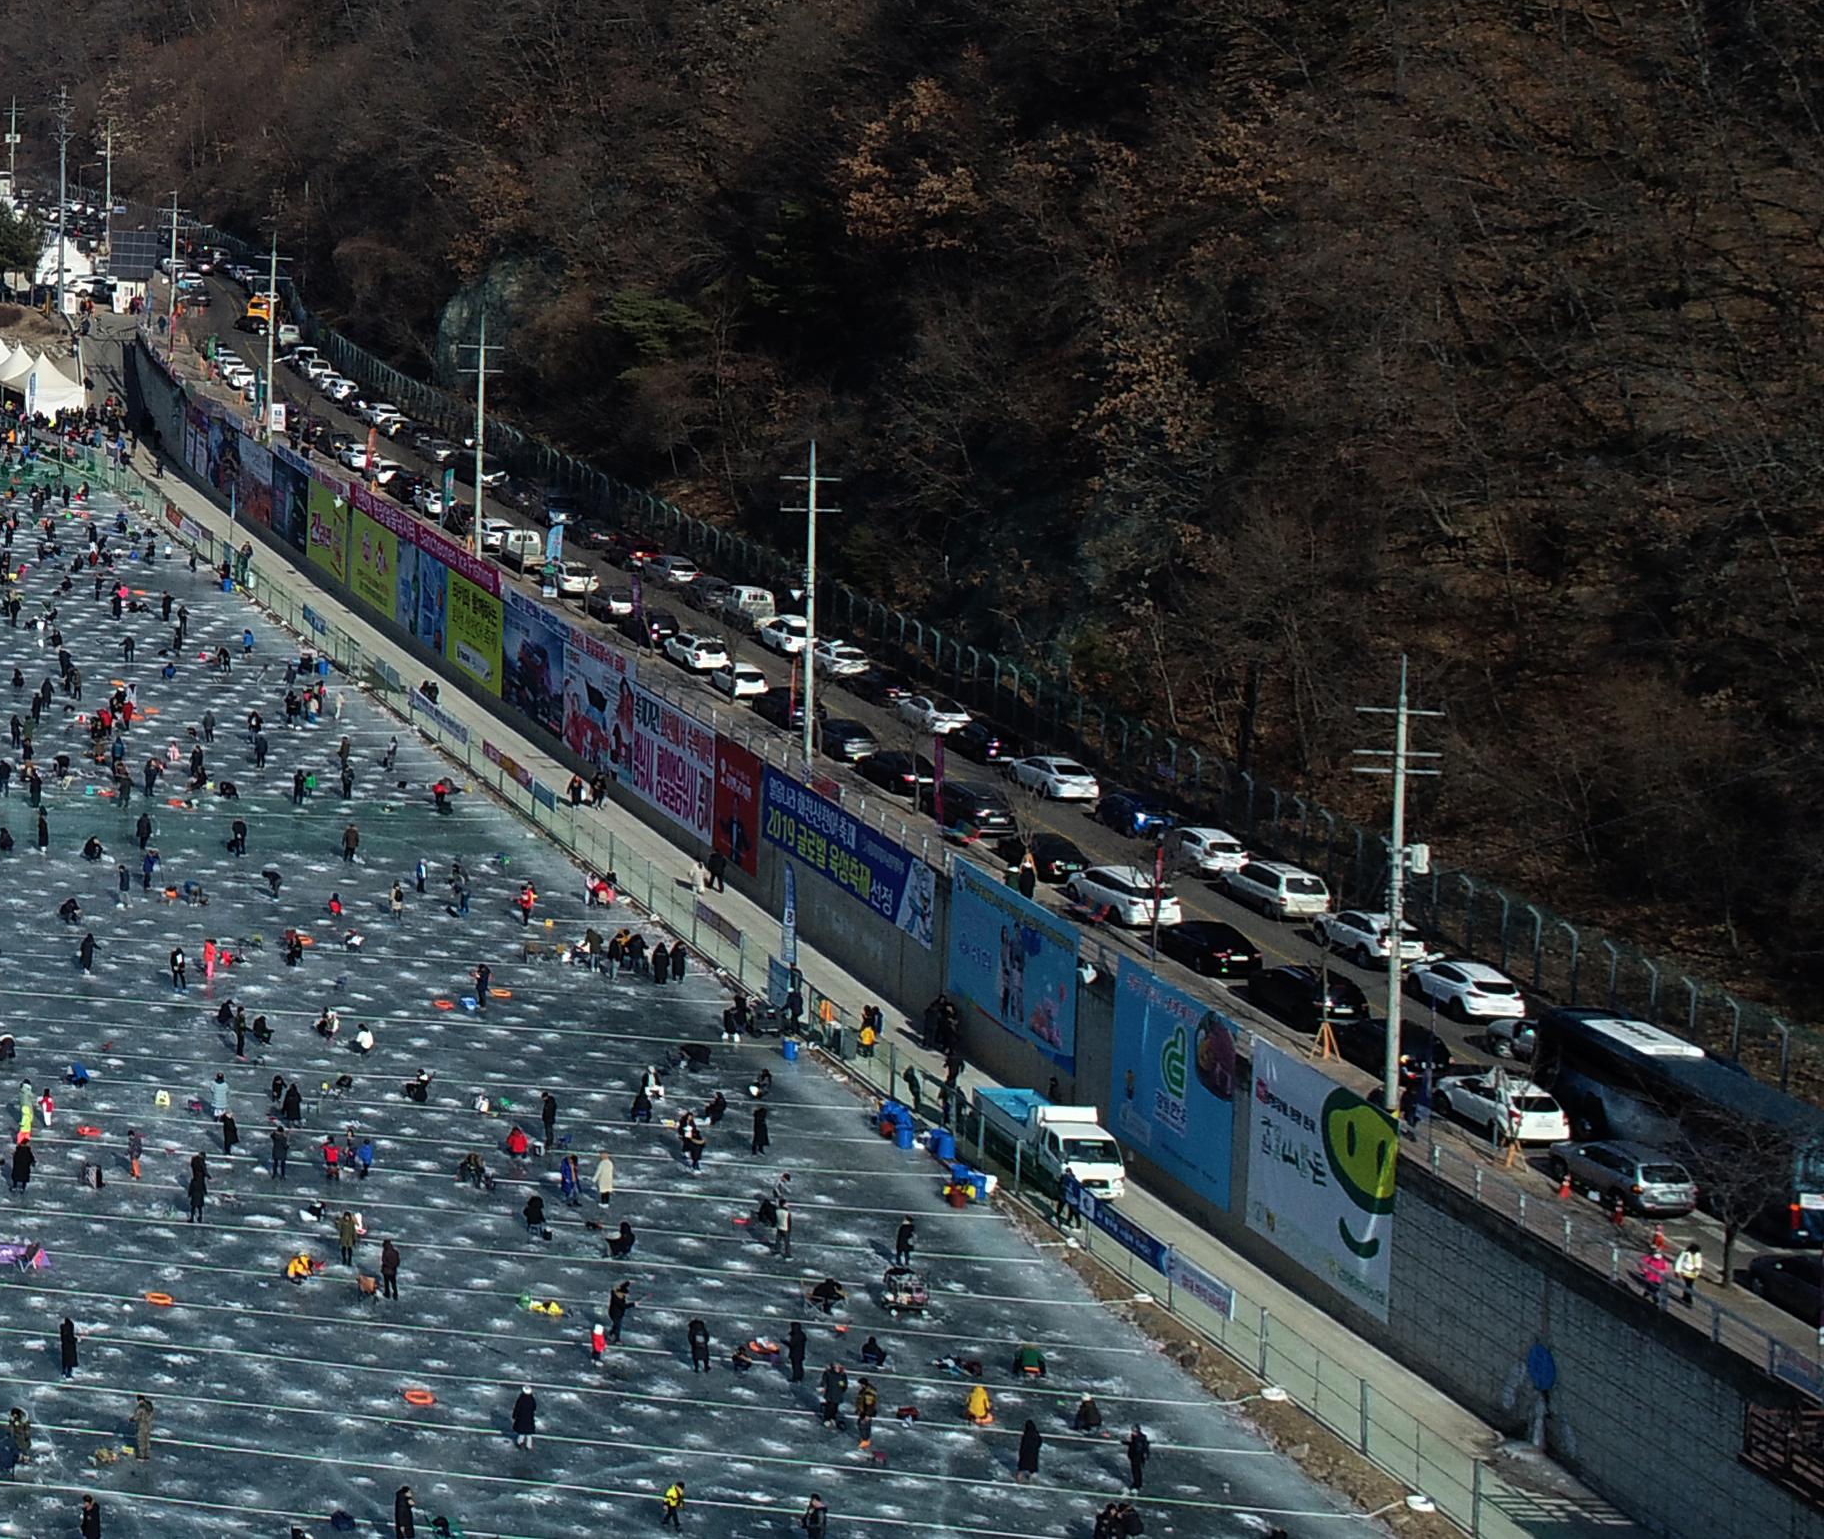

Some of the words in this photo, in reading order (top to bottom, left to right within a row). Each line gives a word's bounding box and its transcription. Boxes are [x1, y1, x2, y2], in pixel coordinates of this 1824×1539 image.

[767, 806, 796, 848] 2019
[797, 824, 827, 871] 글로벌
[829, 844, 872, 901] 육성축제
[871, 879, 893, 916] 선정
